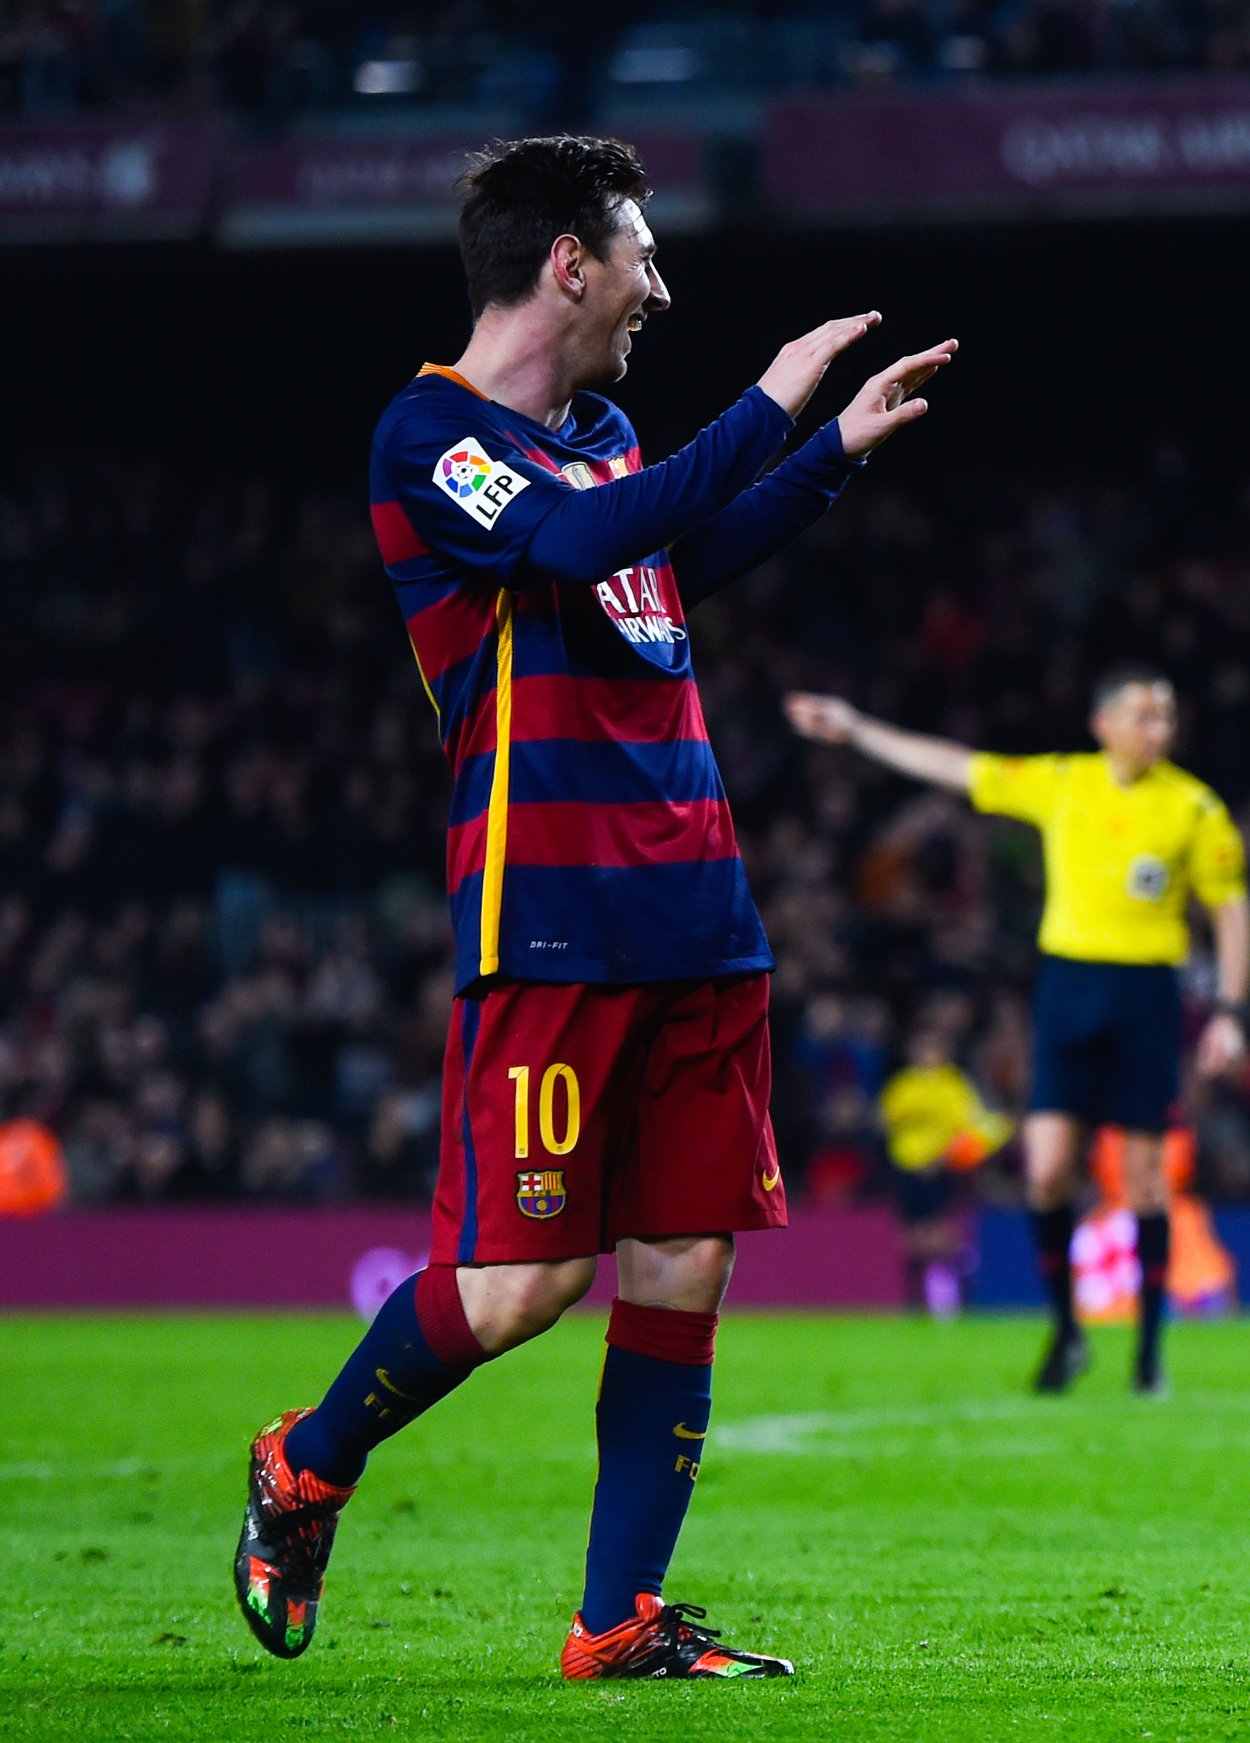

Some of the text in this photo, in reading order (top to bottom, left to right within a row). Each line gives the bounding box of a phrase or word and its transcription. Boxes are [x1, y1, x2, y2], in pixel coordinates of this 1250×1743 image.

[476, 474, 514, 521] LFP
[597, 567, 667, 614] ATAR
[530, 941, 568, 949] DRI-FIT
[508, 1063, 580, 1158] 10
